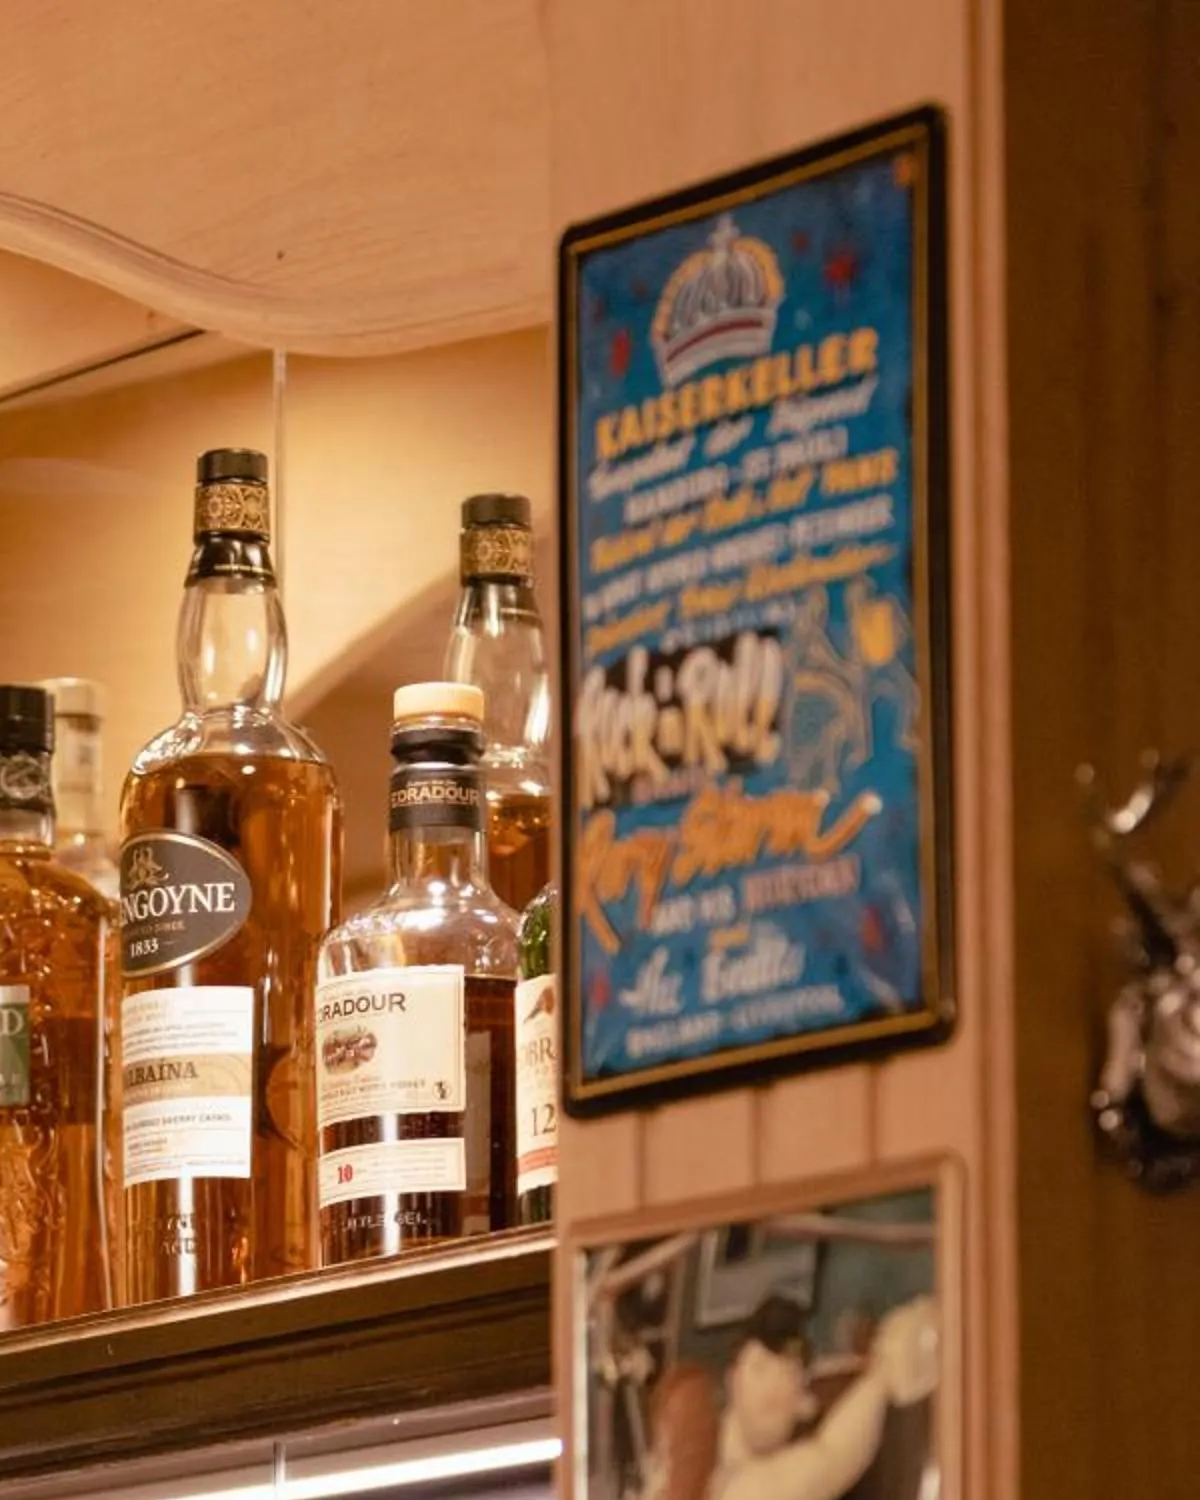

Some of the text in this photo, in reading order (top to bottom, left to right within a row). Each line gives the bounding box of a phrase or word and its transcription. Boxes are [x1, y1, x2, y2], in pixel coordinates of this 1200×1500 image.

[597, 327, 878, 461] KAISERKELLER
[119, 881, 236, 924] NGOYNE
[531, 1103, 557, 1137] 12
[337, 1163, 353, 1184] 10
